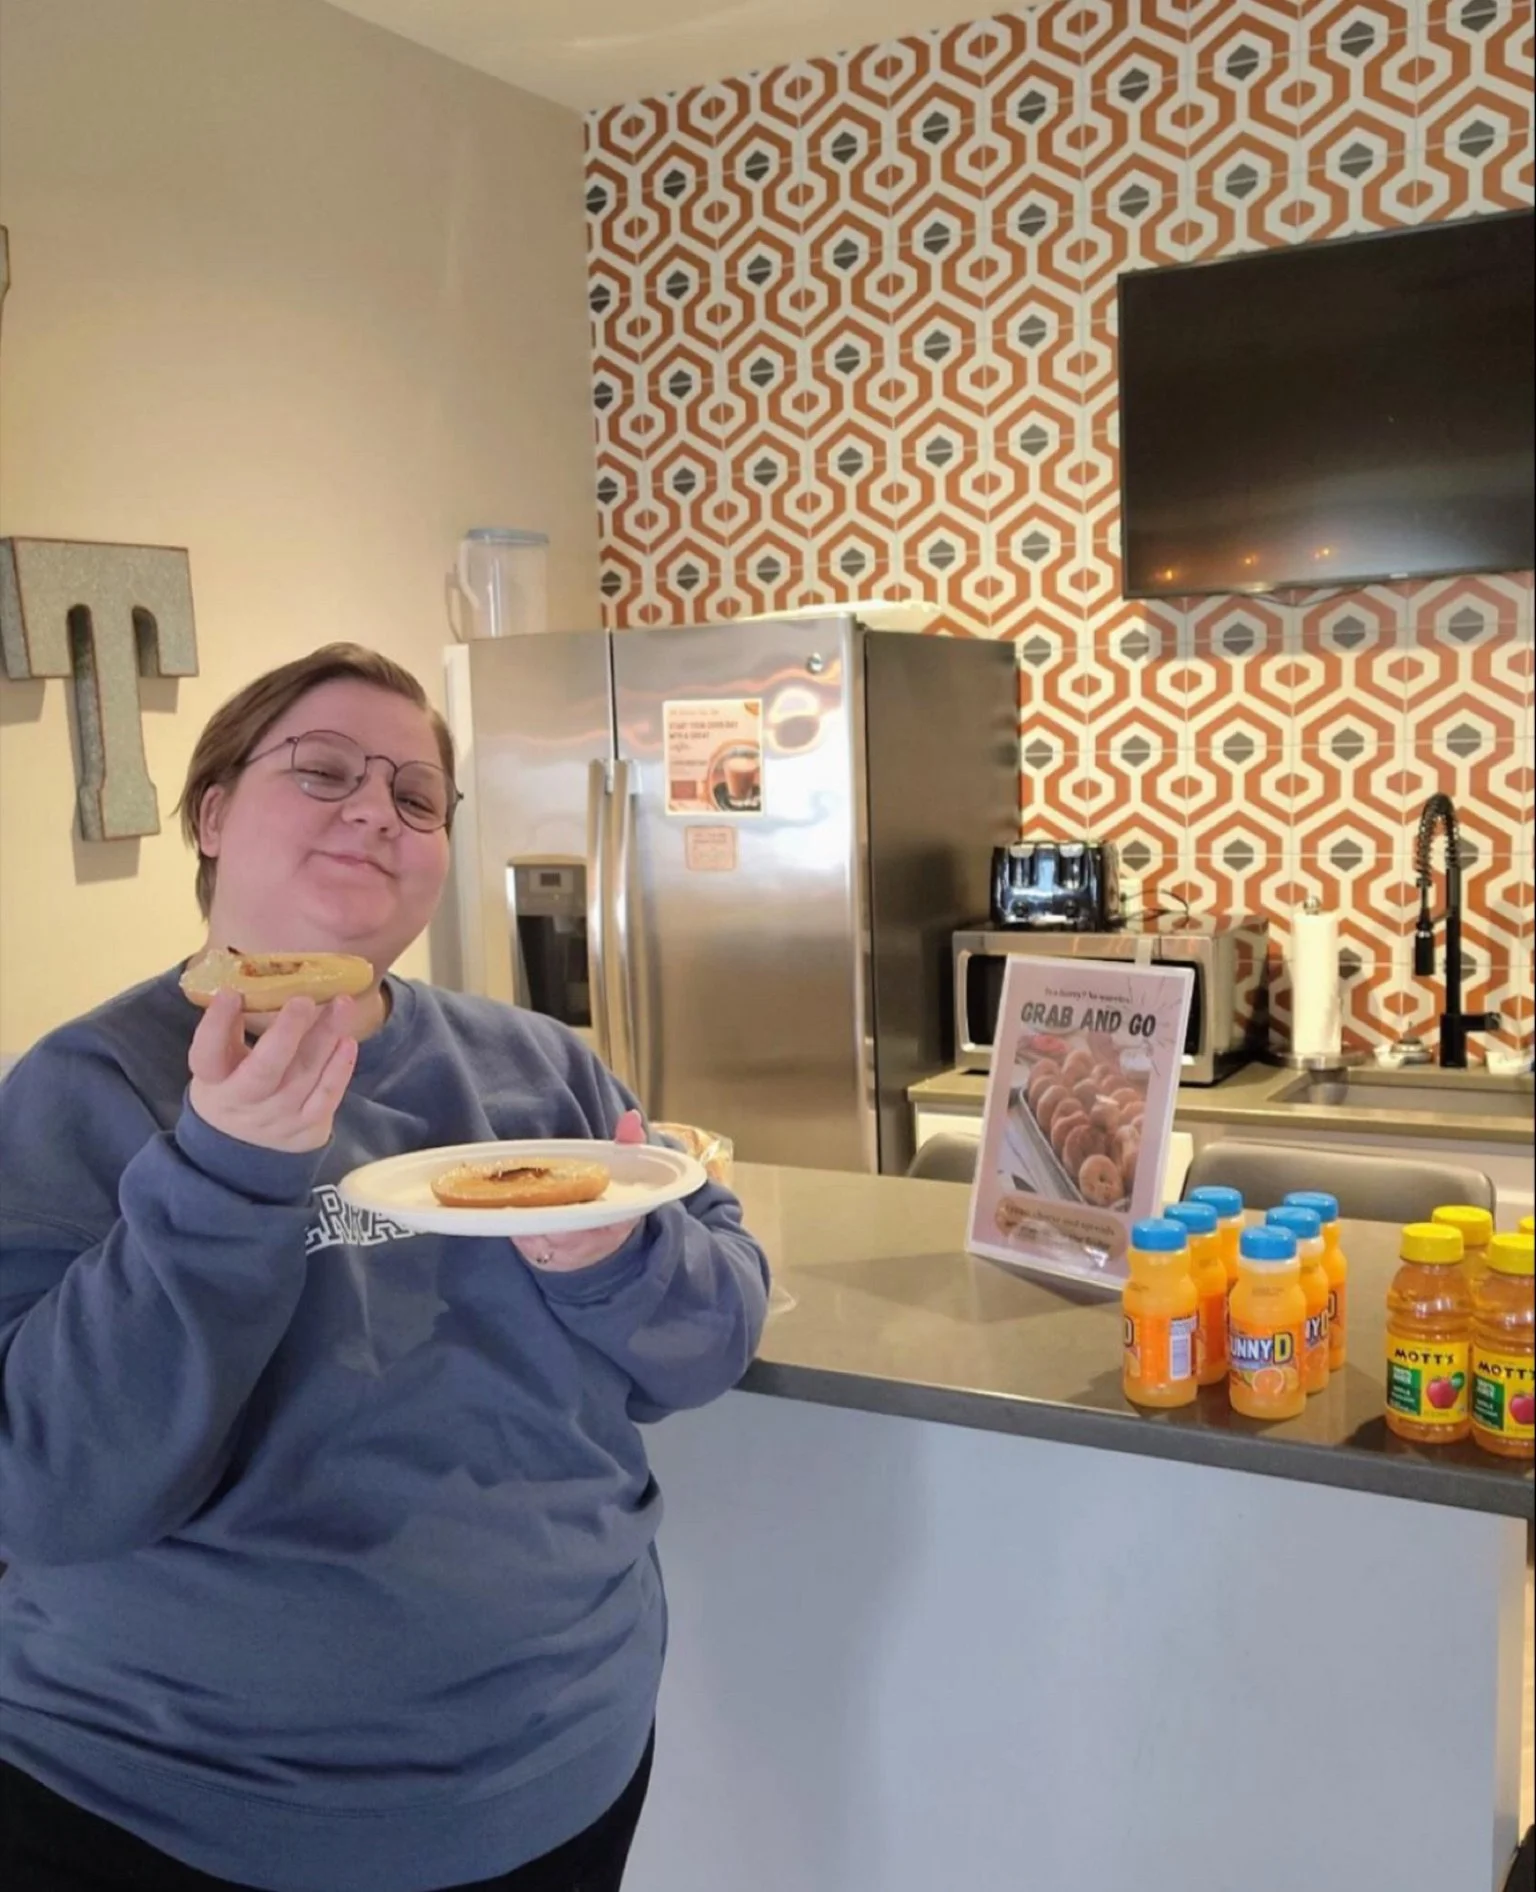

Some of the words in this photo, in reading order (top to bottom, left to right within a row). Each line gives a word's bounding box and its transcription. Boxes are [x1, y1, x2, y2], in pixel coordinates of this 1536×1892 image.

[1020, 1001, 1074, 1029] GRAB
[1080, 1007, 1123, 1033] AND
[1128, 1013, 1157, 1038] GO
[1231, 1332, 1294, 1365] UNNYD
[1394, 1348, 1454, 1365] MOTT'S
